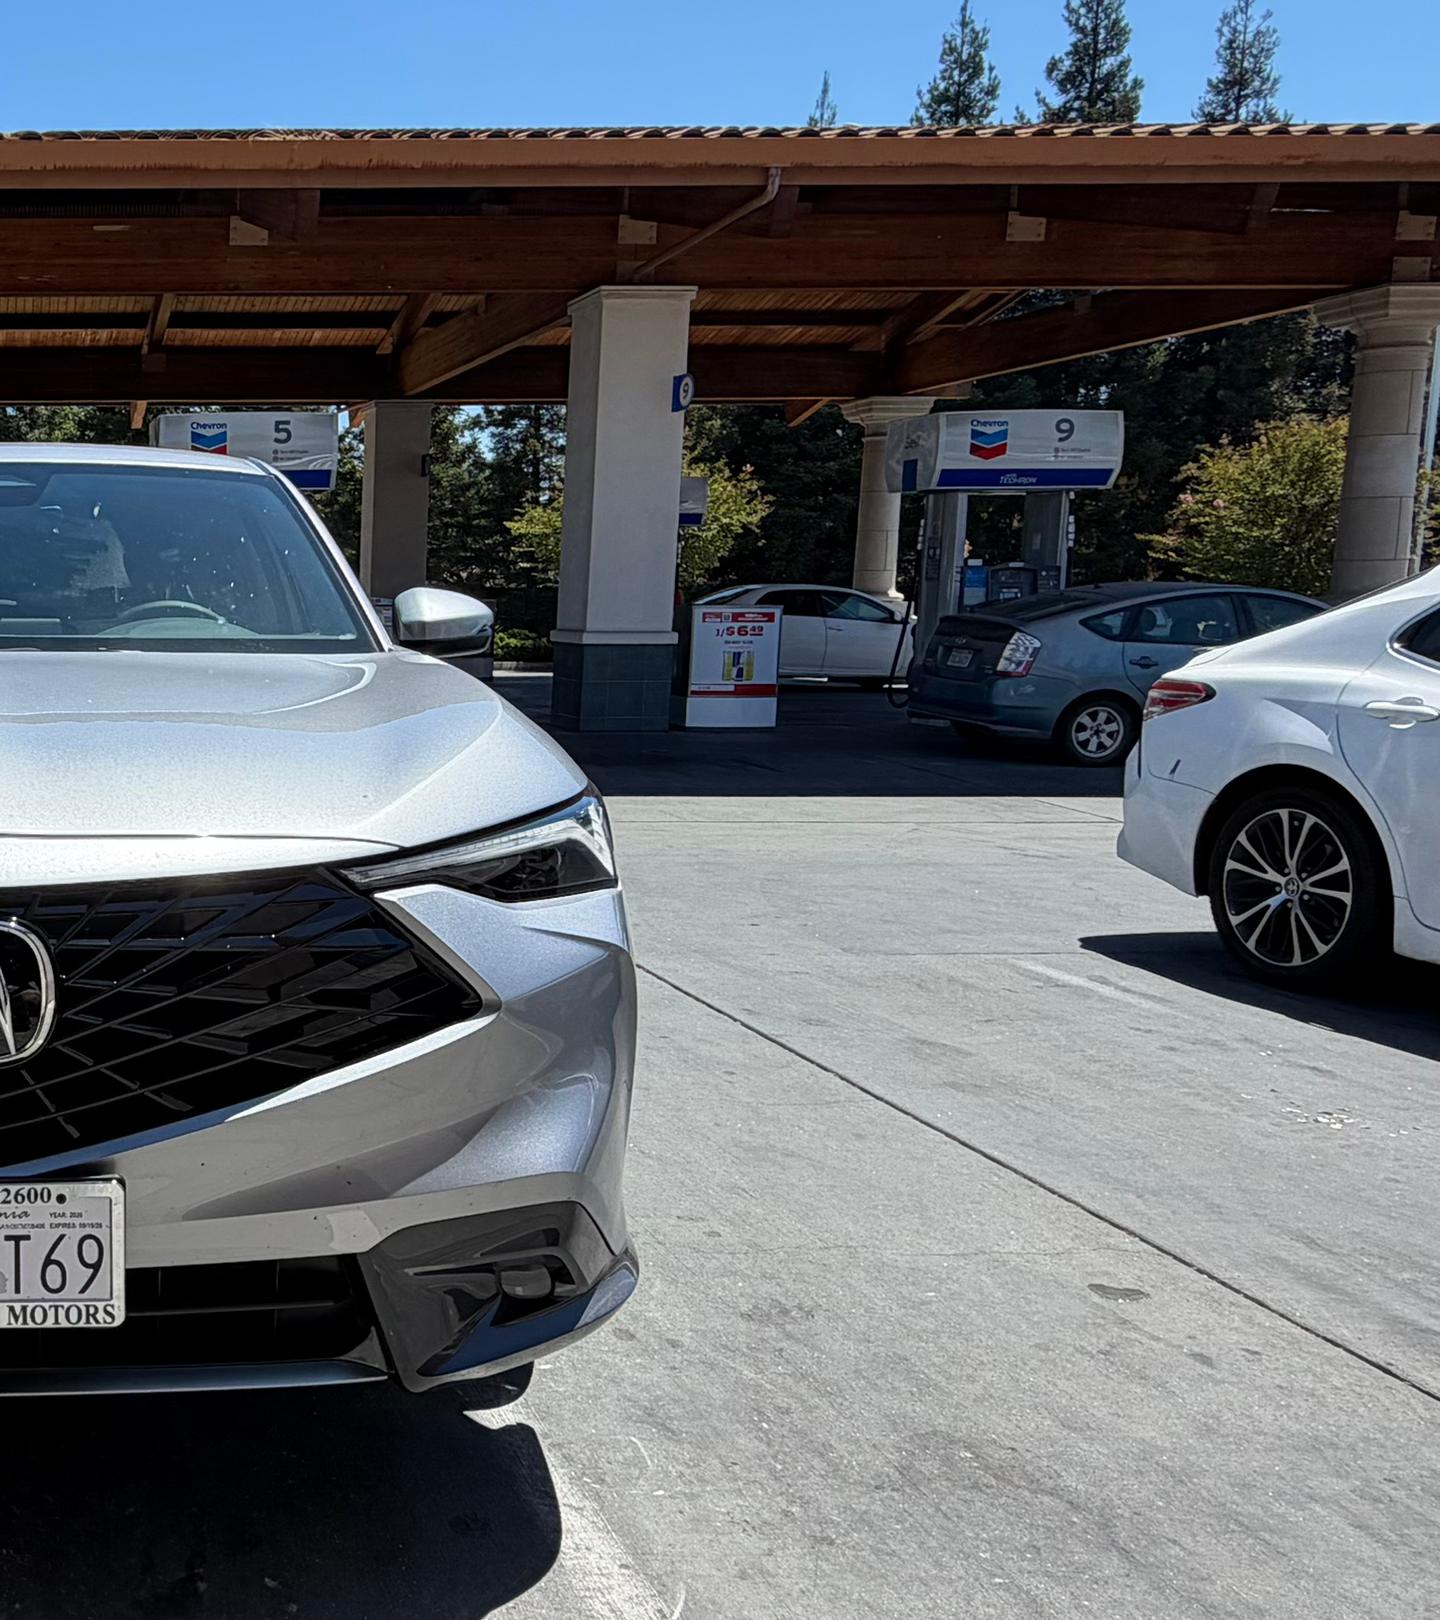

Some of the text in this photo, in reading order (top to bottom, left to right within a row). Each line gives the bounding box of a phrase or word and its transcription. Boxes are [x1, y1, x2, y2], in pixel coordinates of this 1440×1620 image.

[681, 381, 690, 400] 9
[190, 421, 228, 430] Chevron
[273, 420, 293, 445] 5
[970, 418, 1009, 428] Chevron
[1054, 417, 1076, 443] 9
[6, 1303, 116, 1326] MOTORS
